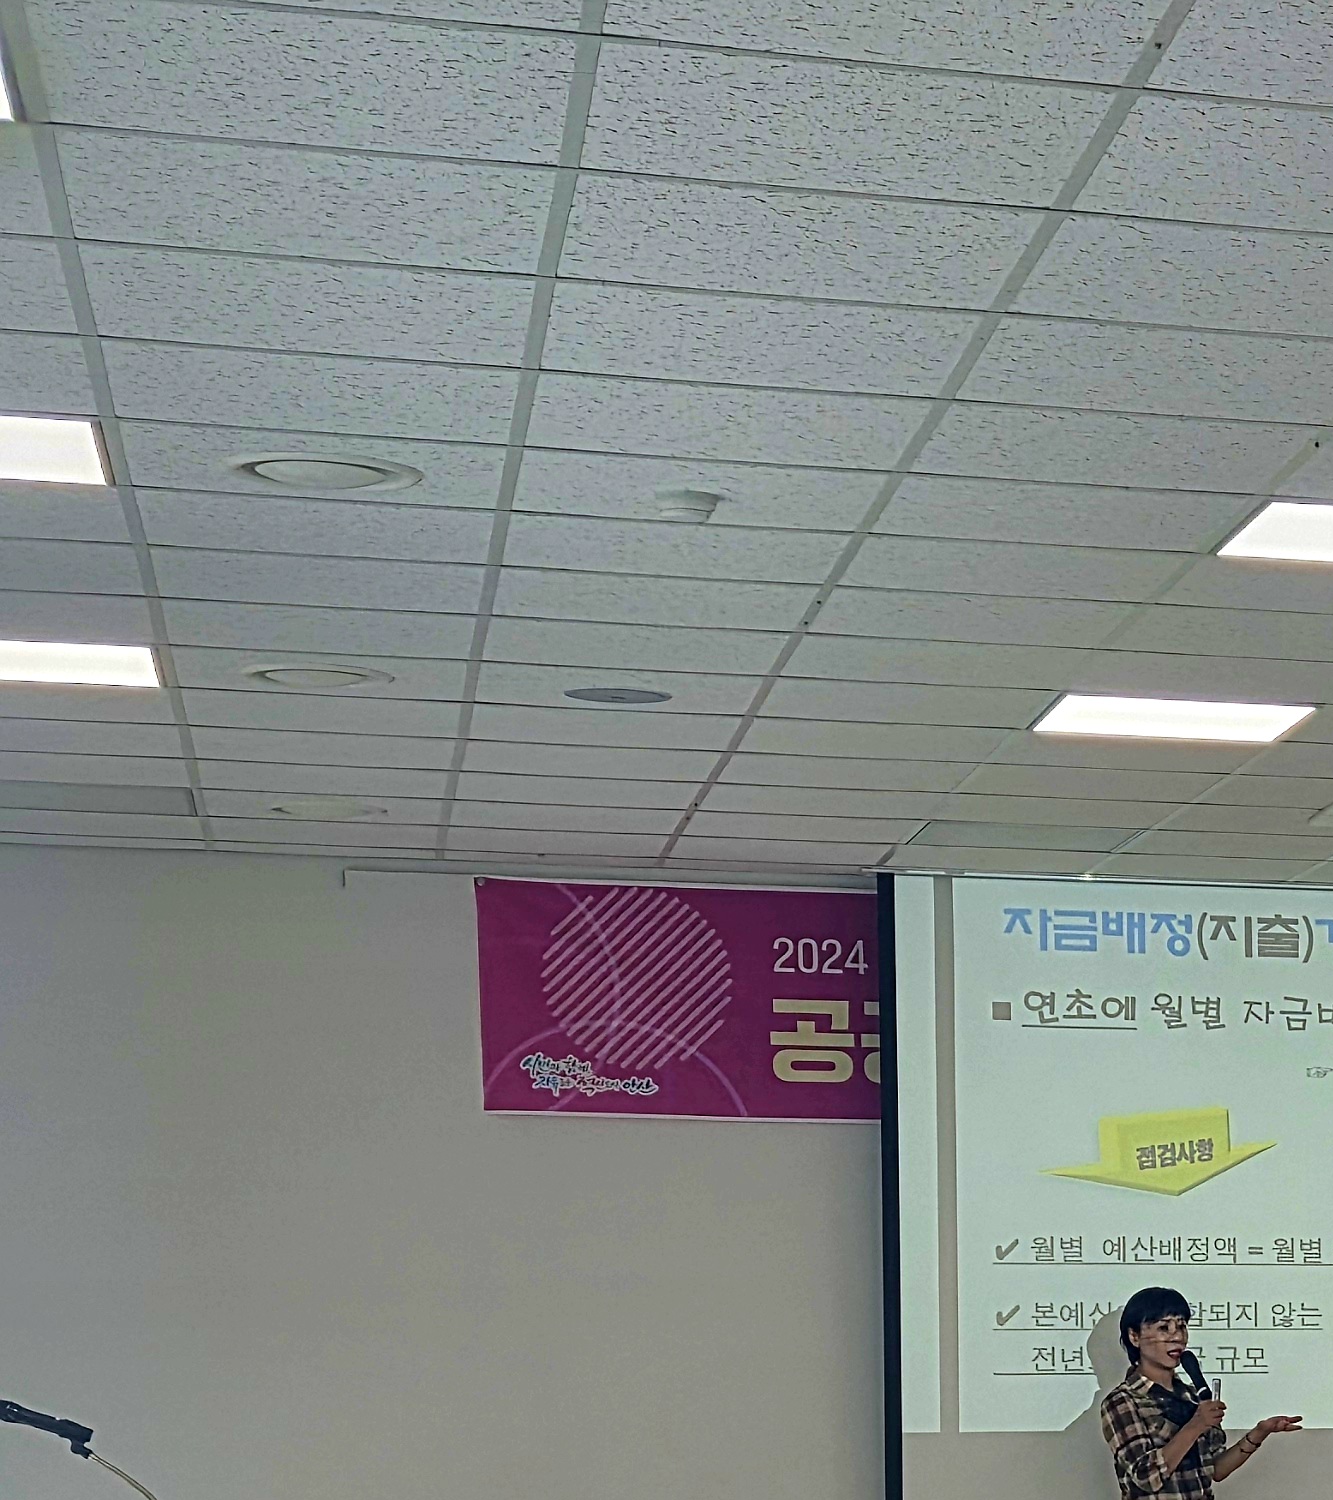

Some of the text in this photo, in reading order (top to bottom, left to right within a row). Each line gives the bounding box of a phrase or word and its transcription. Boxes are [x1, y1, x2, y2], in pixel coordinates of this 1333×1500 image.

[772, 937, 869, 975] 2024
[1023, 988, 1136, 1024] 연초에
[1151, 993, 1226, 1030] 월별
[1136, 1138, 1214, 1170] 점검사항
[1030, 1236, 1083, 1262] 월별
[1103, 1236, 1237, 1264] 예산배정액
[1272, 1237, 1322, 1264] 월별
[1271, 1302, 1323, 1328] 않는
[1031, 1346, 1093, 1372] 전년
[1215, 1346, 1268, 1372] 규모
